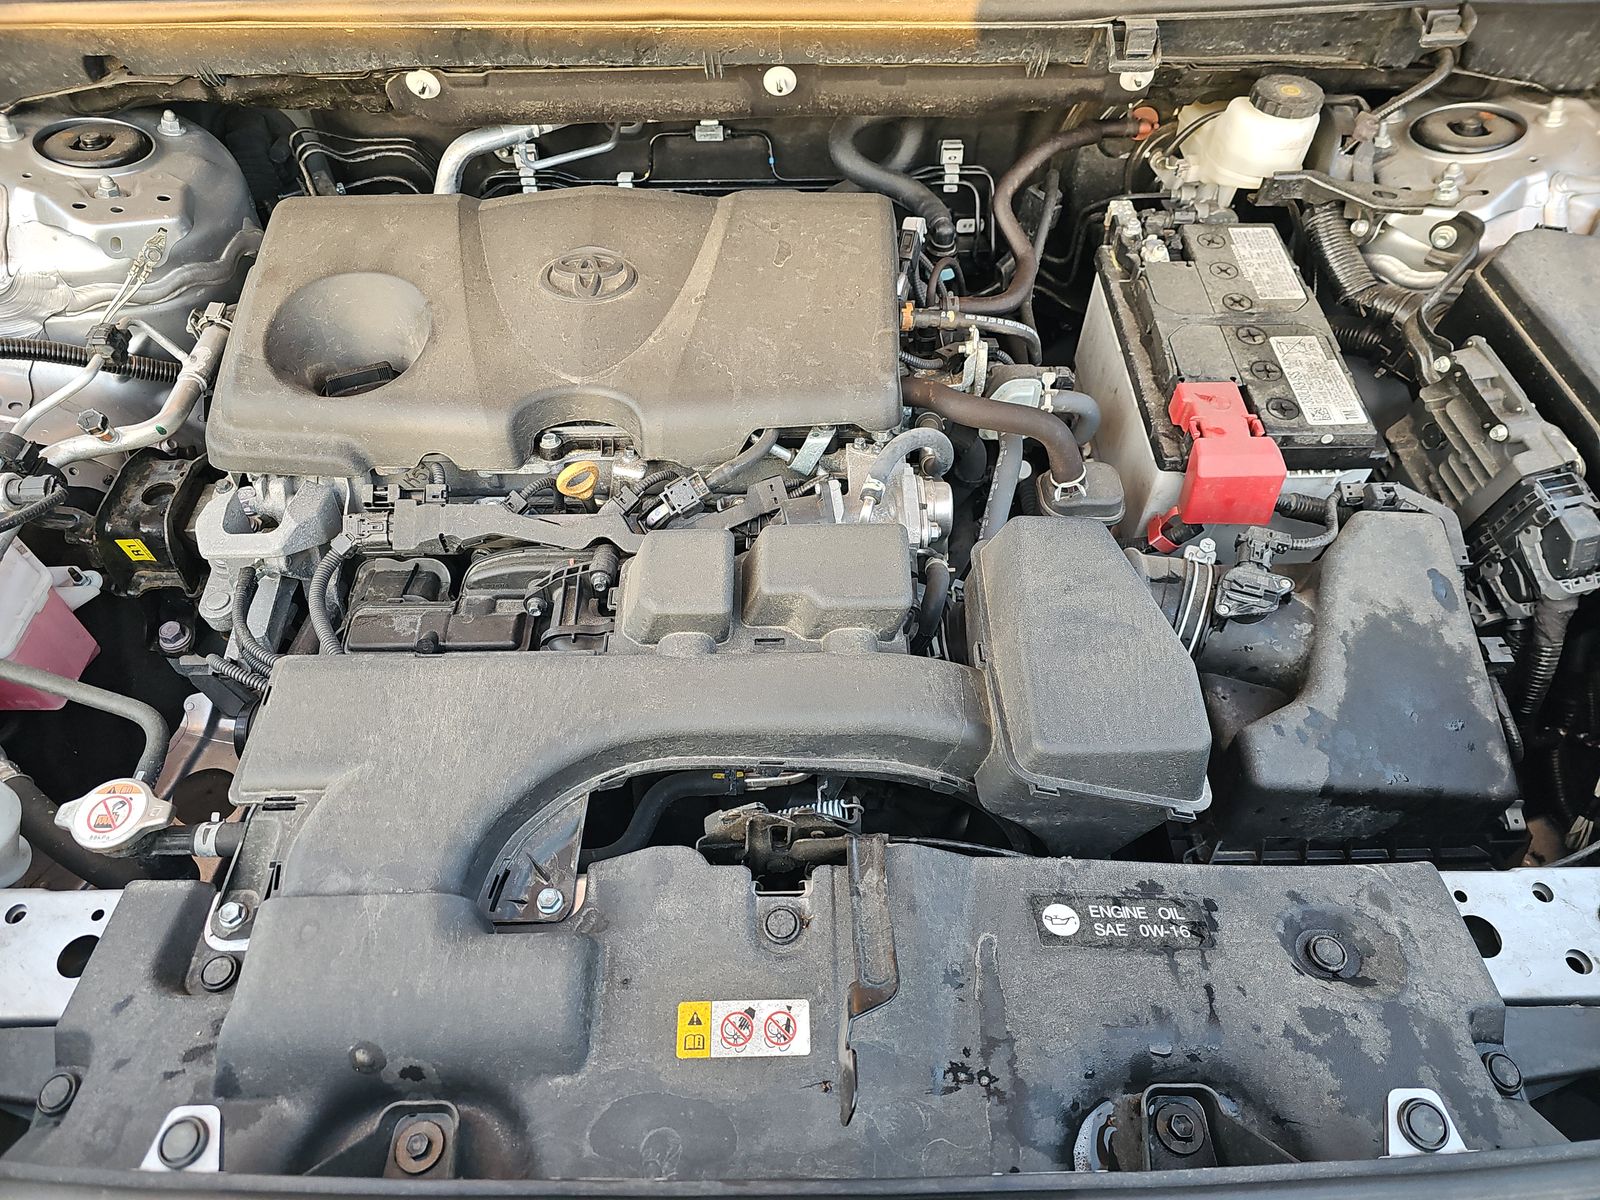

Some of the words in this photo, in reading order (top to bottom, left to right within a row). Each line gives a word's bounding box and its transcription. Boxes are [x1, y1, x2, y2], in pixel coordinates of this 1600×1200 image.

[1088, 905, 1149, 919] ENGINE
[1157, 907, 1186, 920] OIL
[1094, 923, 1129, 937] SAE
[1139, 924, 1191, 938] 0W-16
